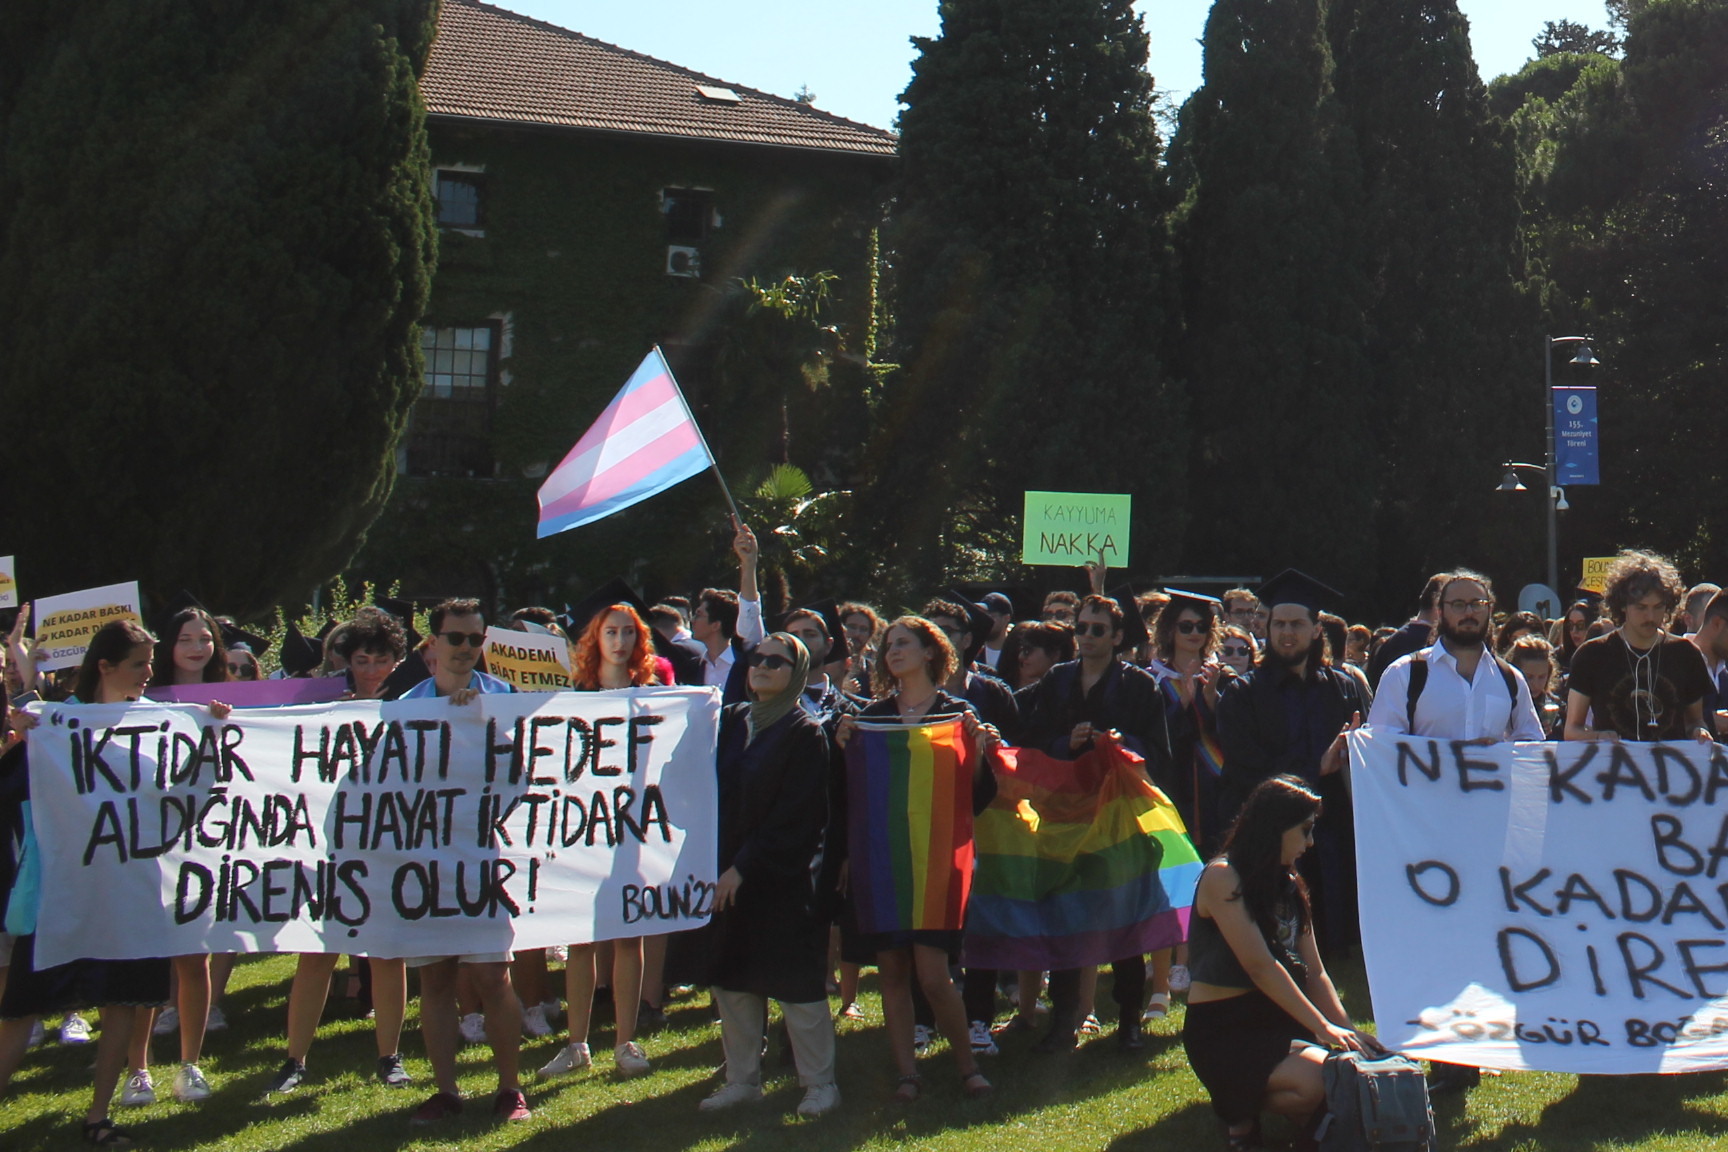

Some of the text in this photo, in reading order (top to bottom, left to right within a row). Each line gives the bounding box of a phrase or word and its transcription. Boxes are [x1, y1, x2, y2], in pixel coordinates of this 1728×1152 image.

[1043, 504, 1117, 525] KAYYUMA
[1040, 531, 1118, 556] NAKKA
[42, 617, 59, 628] NE
[59, 610, 97, 625] KADAR
[99, 604, 132, 617] BASKI
[51, 626, 89, 641] KADAR
[491, 641, 557, 664] AKADEMİ
[489, 662, 572, 688] BİAT ETMEZ
[290, 719, 450, 785] HAYATI
[484, 715, 665, 786] HEDEF
[1397, 740, 1506, 794] NE
[82, 784, 672, 866] ALDIĞINDA HAYAT İKTİDARA
[174, 853, 370, 938] DİRENİŞ
[1405, 860, 1461, 908] O
